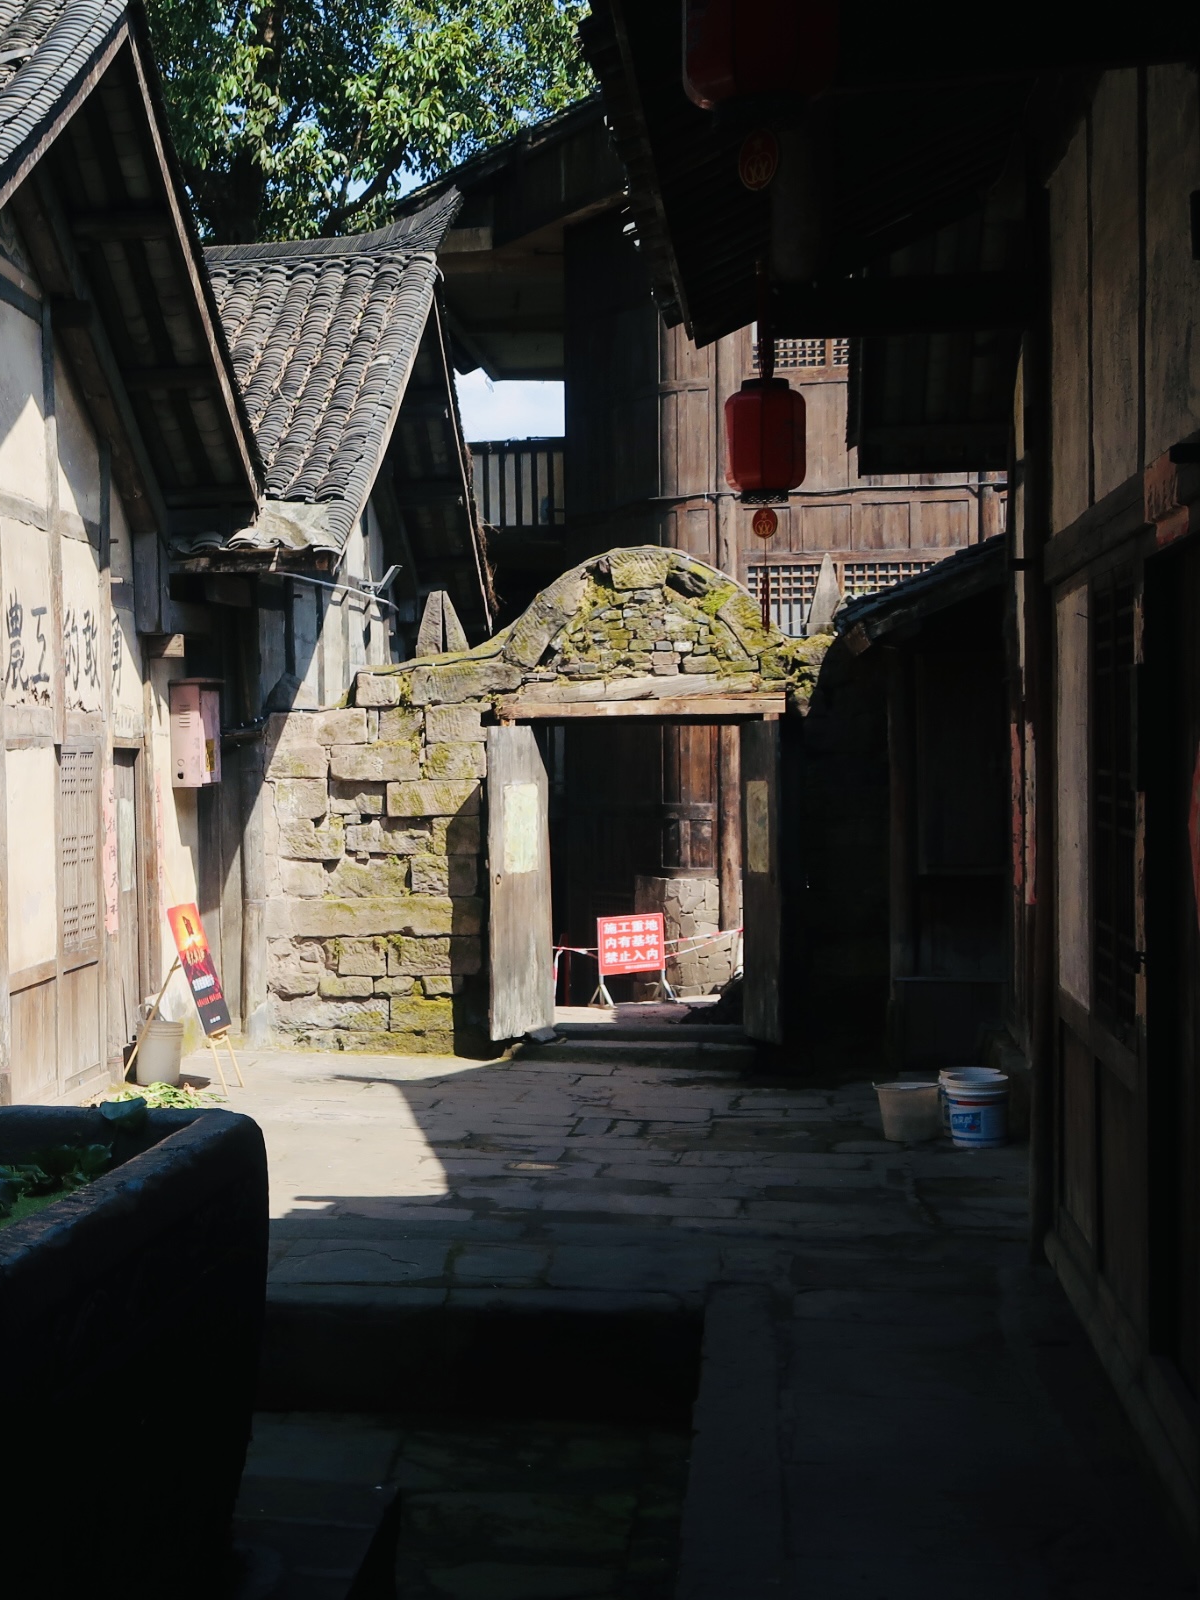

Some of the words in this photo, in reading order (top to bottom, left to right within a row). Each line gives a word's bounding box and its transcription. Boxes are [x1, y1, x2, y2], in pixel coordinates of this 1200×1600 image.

[603, 919, 659, 935] 施工重地
[604, 934, 659, 949] 内有基坑
[604, 948, 659, 964] 禁止入内
